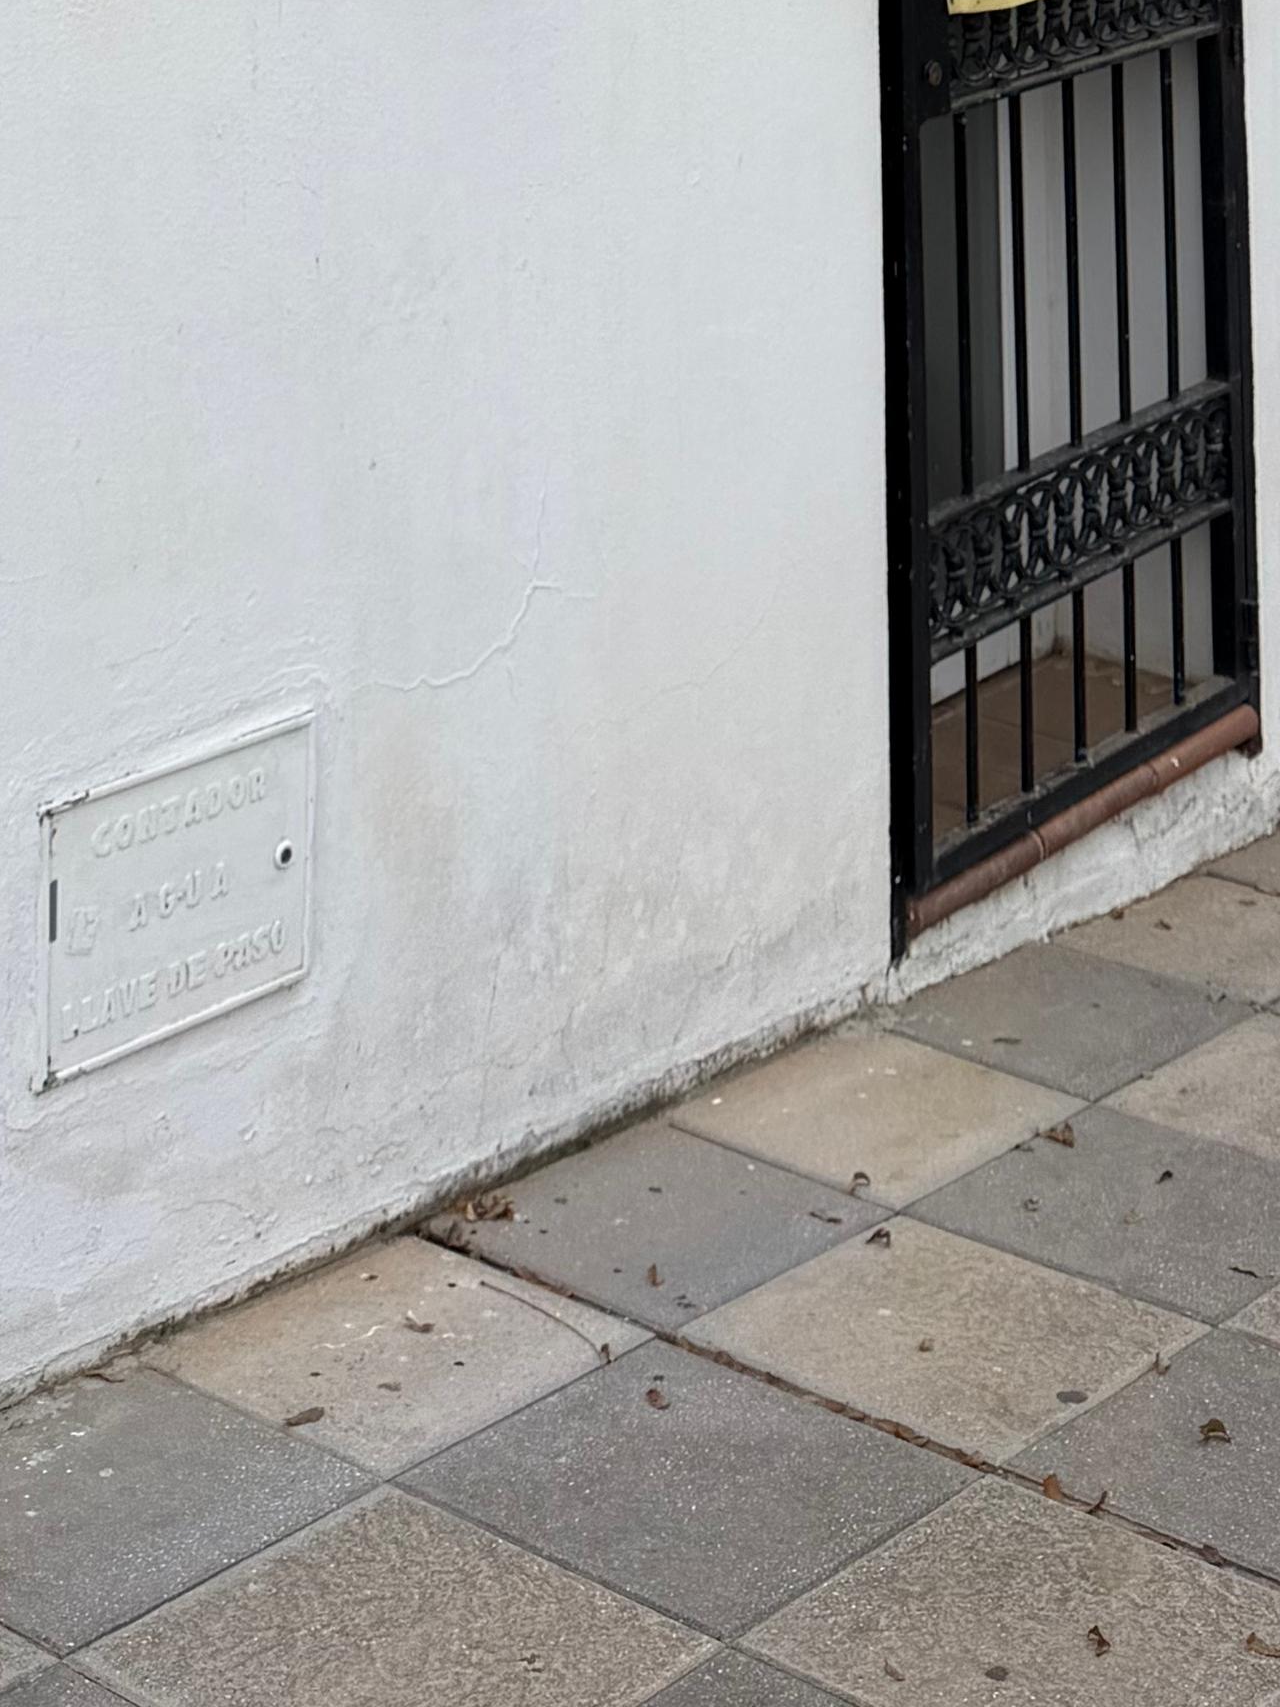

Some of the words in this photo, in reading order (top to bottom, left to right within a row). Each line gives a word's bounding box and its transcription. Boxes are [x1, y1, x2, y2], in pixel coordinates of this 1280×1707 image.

[91, 766, 266, 858] CONTADOR
[129, 862, 229, 933] AGUA
[166, 951, 206, 995] DE
[215, 920, 286, 978] PASO
